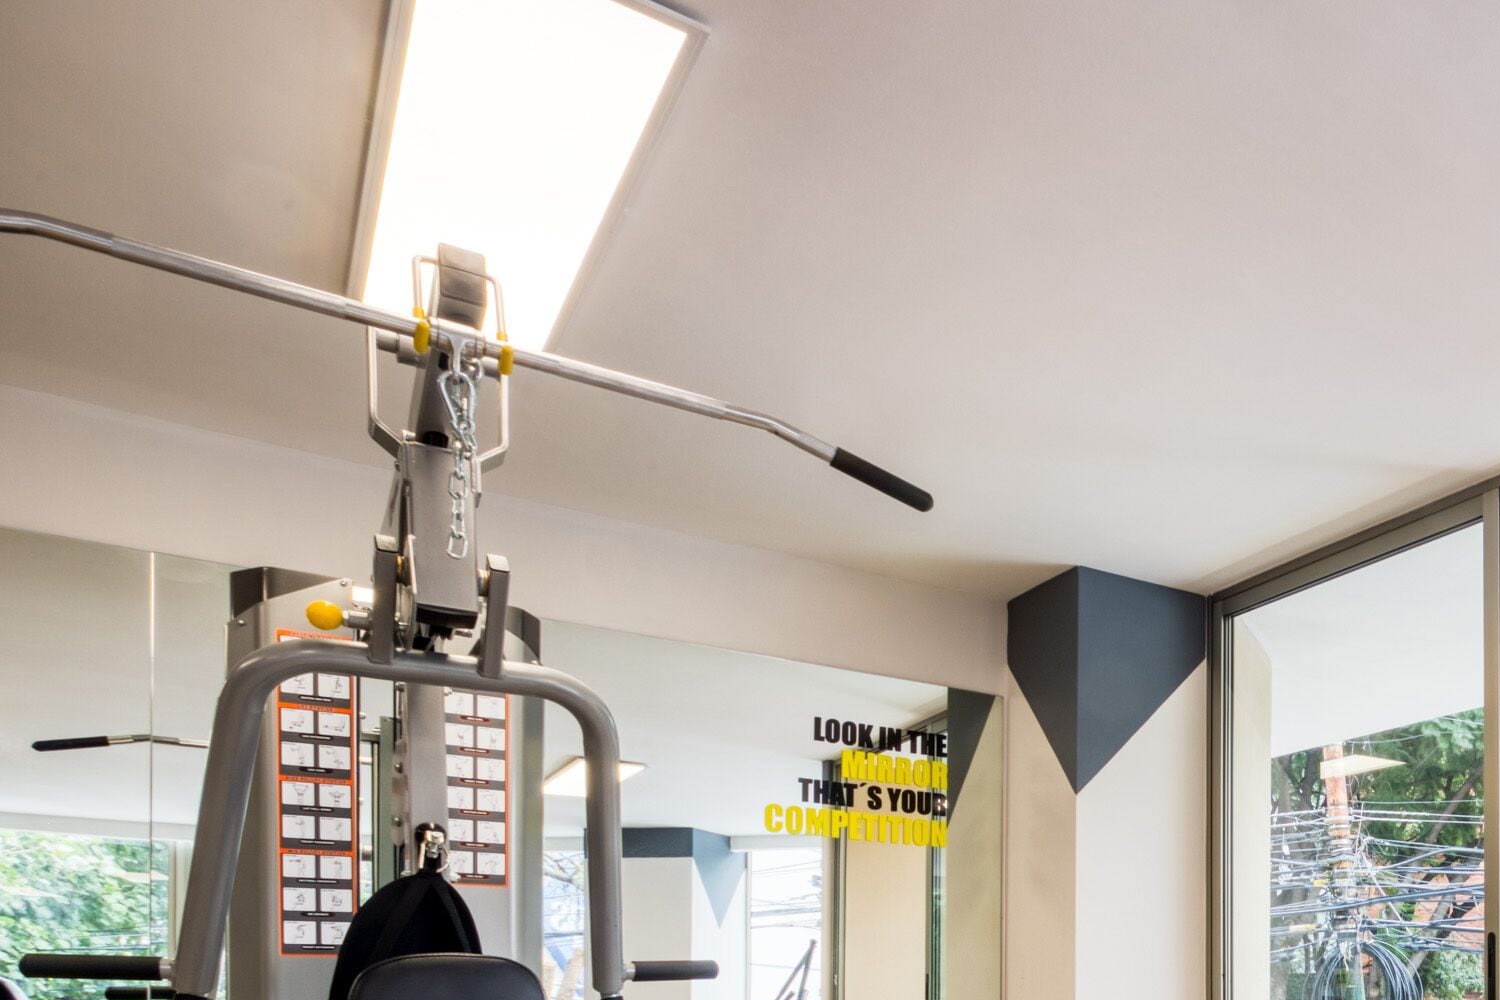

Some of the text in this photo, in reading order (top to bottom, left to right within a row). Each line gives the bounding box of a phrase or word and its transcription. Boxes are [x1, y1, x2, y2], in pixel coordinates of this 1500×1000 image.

[813, 716, 948, 757] LOOK IN THE
[841, 749, 948, 790] MIRROR
[887, 788, 948, 817] YOUR
[764, 803, 947, 848] COMPETITION
